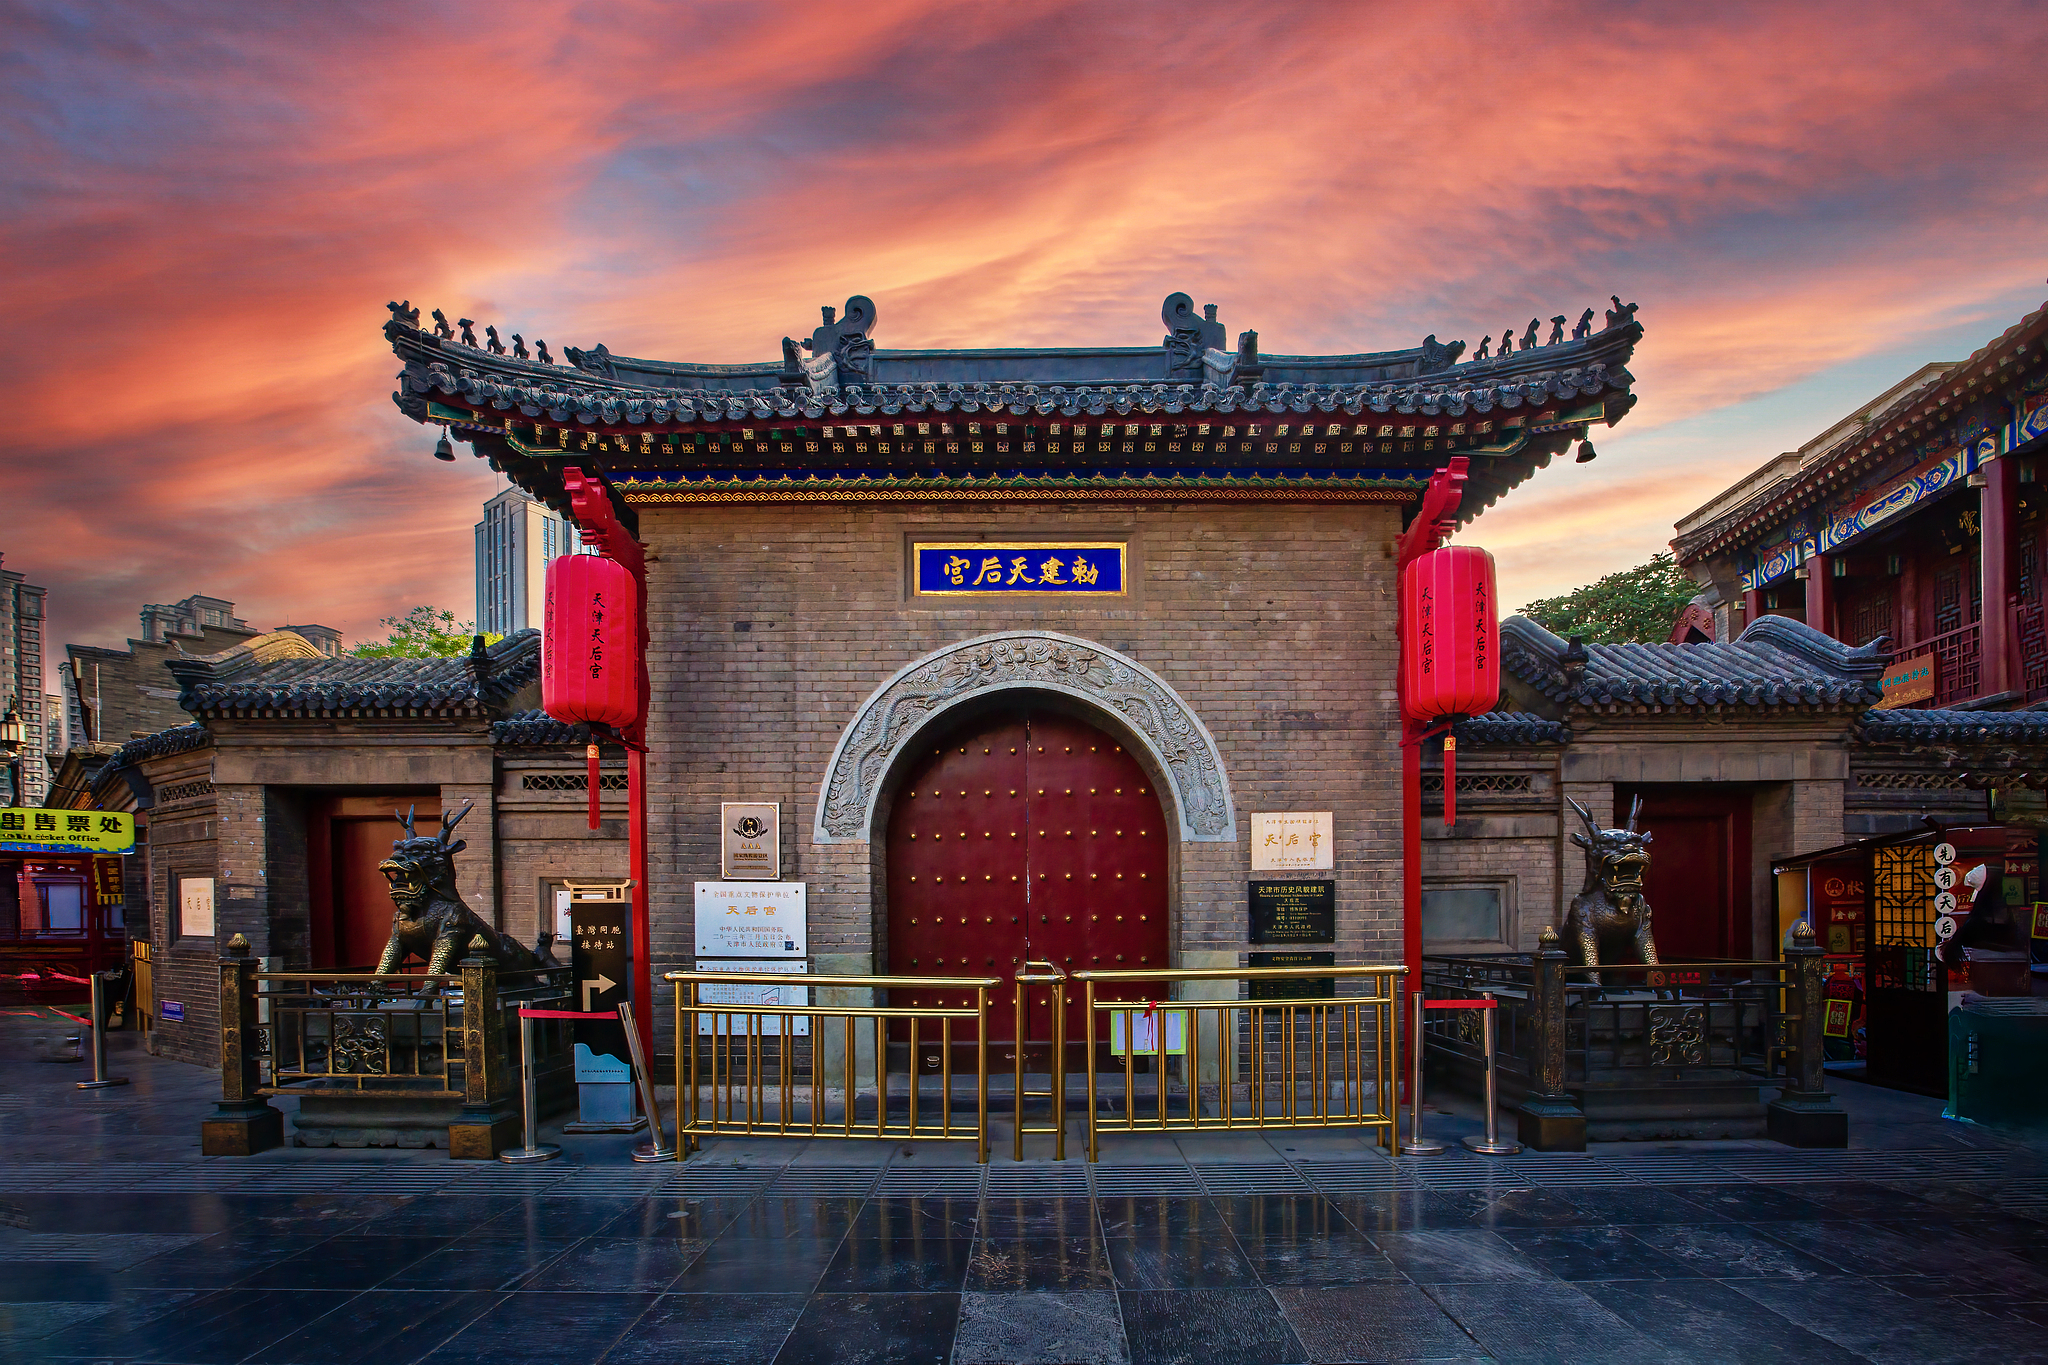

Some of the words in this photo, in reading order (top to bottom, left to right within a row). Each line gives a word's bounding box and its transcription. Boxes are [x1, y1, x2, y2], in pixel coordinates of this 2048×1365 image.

[1421, 587, 1433, 674] 天津天后宫
[1475, 582, 1487, 669] 天津天后宫
[589, 592, 606, 679] 天津天后宫
[69, 834, 100, 842] Office
[1264, 831, 1322, 847] 天后宫
[726, 905, 777, 916] 天后宫
[581, 939, 615, 950] 接待站
